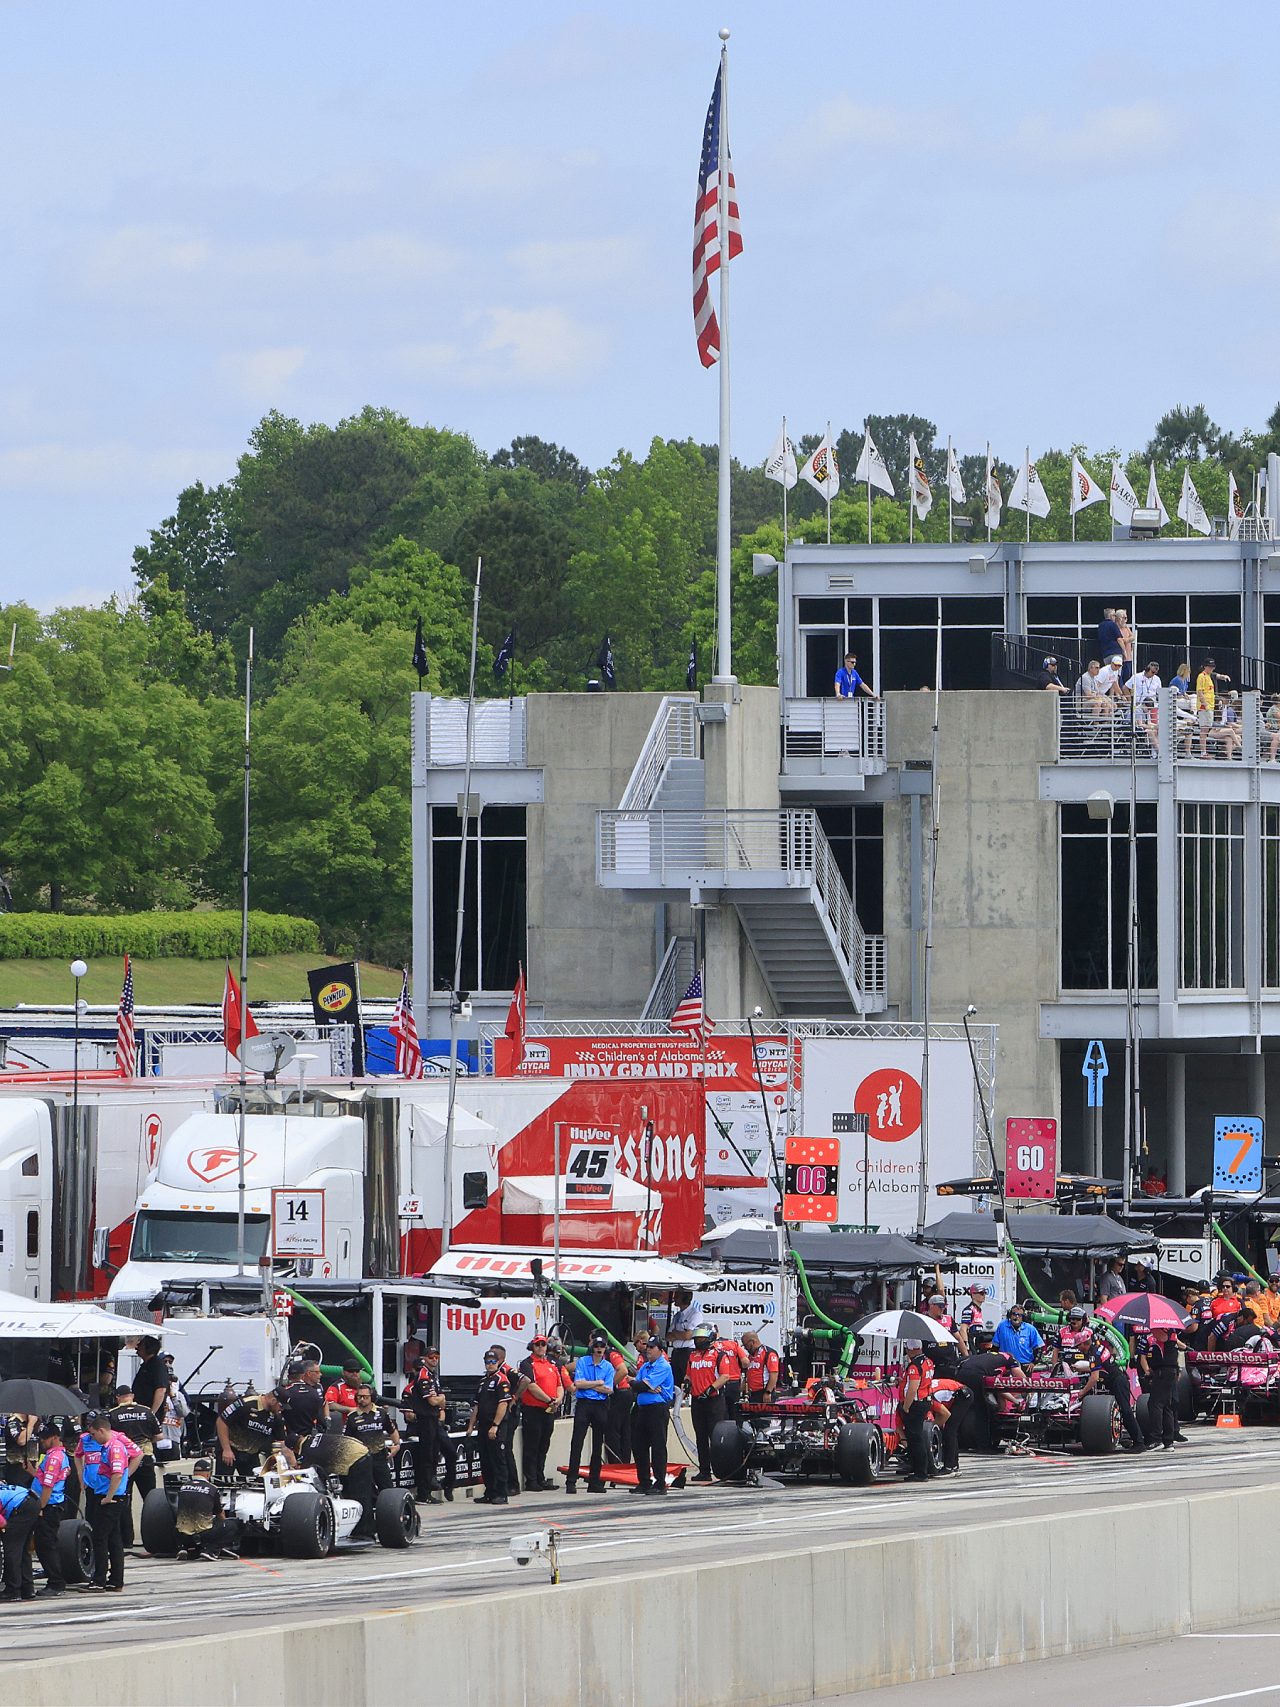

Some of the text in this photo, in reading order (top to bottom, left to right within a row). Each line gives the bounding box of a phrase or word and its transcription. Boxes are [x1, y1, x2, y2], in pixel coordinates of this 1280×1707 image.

[529, 1049, 547, 1058] NTT
[597, 1050, 705, 1062] Children's of Alabama
[769, 1048, 787, 1056] NTT
[563, 1062, 739, 1078] INDY GRAND PRIX
[569, 1127, 612, 1143] HyVee
[614, 1132, 700, 1183] estone
[1017, 1145, 1045, 1172] 60
[1223, 1131, 1254, 1175] 7
[569, 1149, 610, 1179] 45
[796, 1165, 828, 1195] 06
[848, 1178, 865, 1193] of
[286, 1199, 309, 1221] 14
[956, 1262, 995, 1275] Nation
[446, 1308, 527, 1336] HyVee
[1195, 1352, 1263, 1363] AutoNation
[993, 1377, 1064, 1389] AutoNation
[177, 1474, 257, 1484] BNILE
[341, 1506, 361, 1520] BITN
